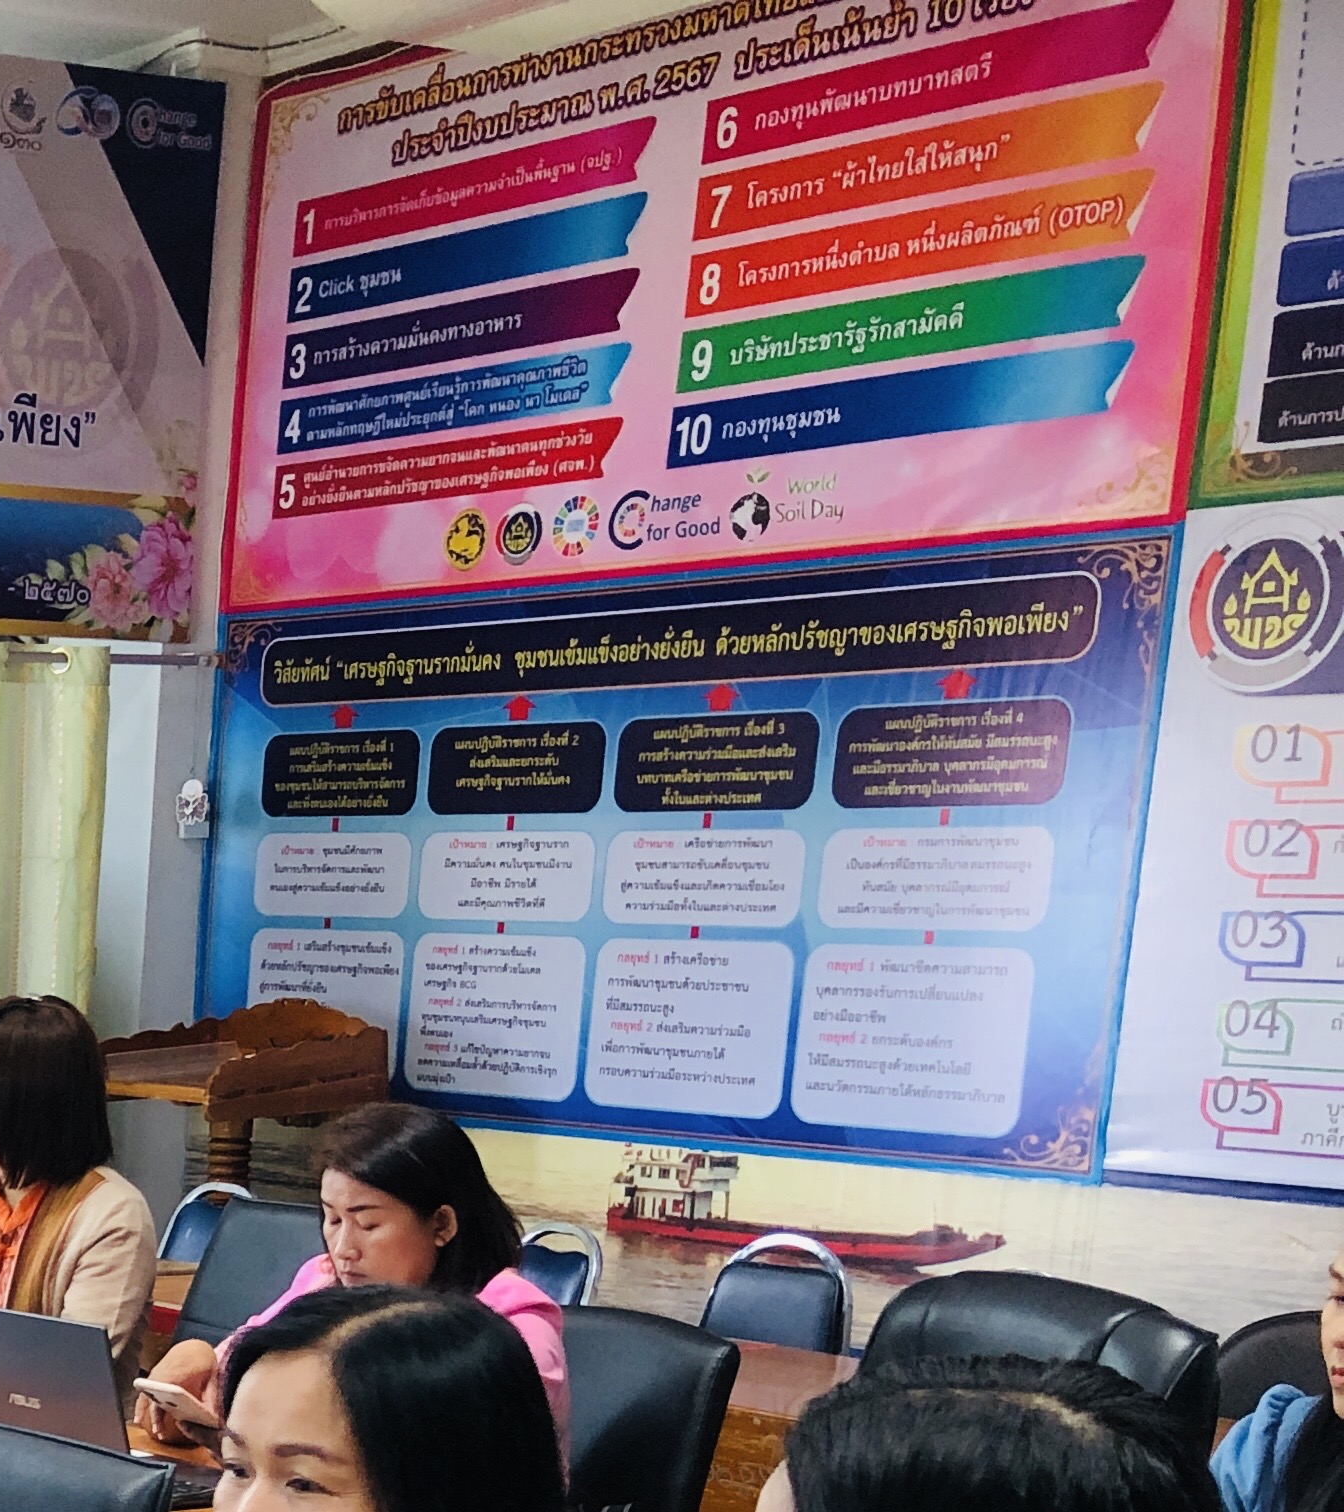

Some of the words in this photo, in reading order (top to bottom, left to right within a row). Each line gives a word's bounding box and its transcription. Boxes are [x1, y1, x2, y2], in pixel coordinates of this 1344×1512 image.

[392, 90, 592, 166] ประจำปีงบประมาณ
[599, 71, 650, 115] พ.ศ.
[654, 54, 722, 98] 2567
[715, 106, 738, 150] 6
[753, 51, 993, 131] กองทุนพัฒนาบทบาทสตรี
[710, 186, 733, 229] 7
[746, 177, 824, 209] โครงการ
[832, 135, 1011, 192] “ผ้าไทยใส่ให้สนุก”
[302, 209, 315, 245] 1
[699, 263, 722, 305] 8
[737, 238, 900, 289] โครงการหนึ่งตำบล
[906, 209, 1041, 258] หนึ่งผลิตภัณฑ์
[1048, 195, 1124, 239] (OTOP)
[294, 276, 313, 314] 2
[318, 280, 355, 300] Click
[359, 266, 402, 298] ชุมชน
[288, 343, 307, 380] 3
[313, 313, 523, 367] การสร้างความมั่นคงทางอาหาร
[690, 340, 713, 382] 9
[284, 409, 302, 445] 4
[675, 413, 713, 457] 10
[721, 403, 841, 443] กองทุนชุมชน
[278, 474, 296, 510] 5
[787, 473, 838, 495] World
[646, 522, 672, 542] for
[675, 517, 721, 539] Good
[774, 500, 807, 523] Soil
[811, 498, 844, 524] Day
[273, 655, 331, 685] วิสัยทัศน์
[336, 642, 502, 690] “เศรษฐกิจฐานรากมั่นคง
[514, 627, 705, 679] ชุมชนเข้มแข็งอย่างยั่งยืน
[715, 602, 1084, 658] ด้วยหลักปรัชญาของเศรษฐกิจพอเพียง”
[1250, 723, 1303, 764] 01
[1243, 818, 1304, 858] 02
[1231, 910, 1289, 949] 03
[1224, 999, 1281, 1039] 04
[1212, 1076, 1270, 1115] 05
